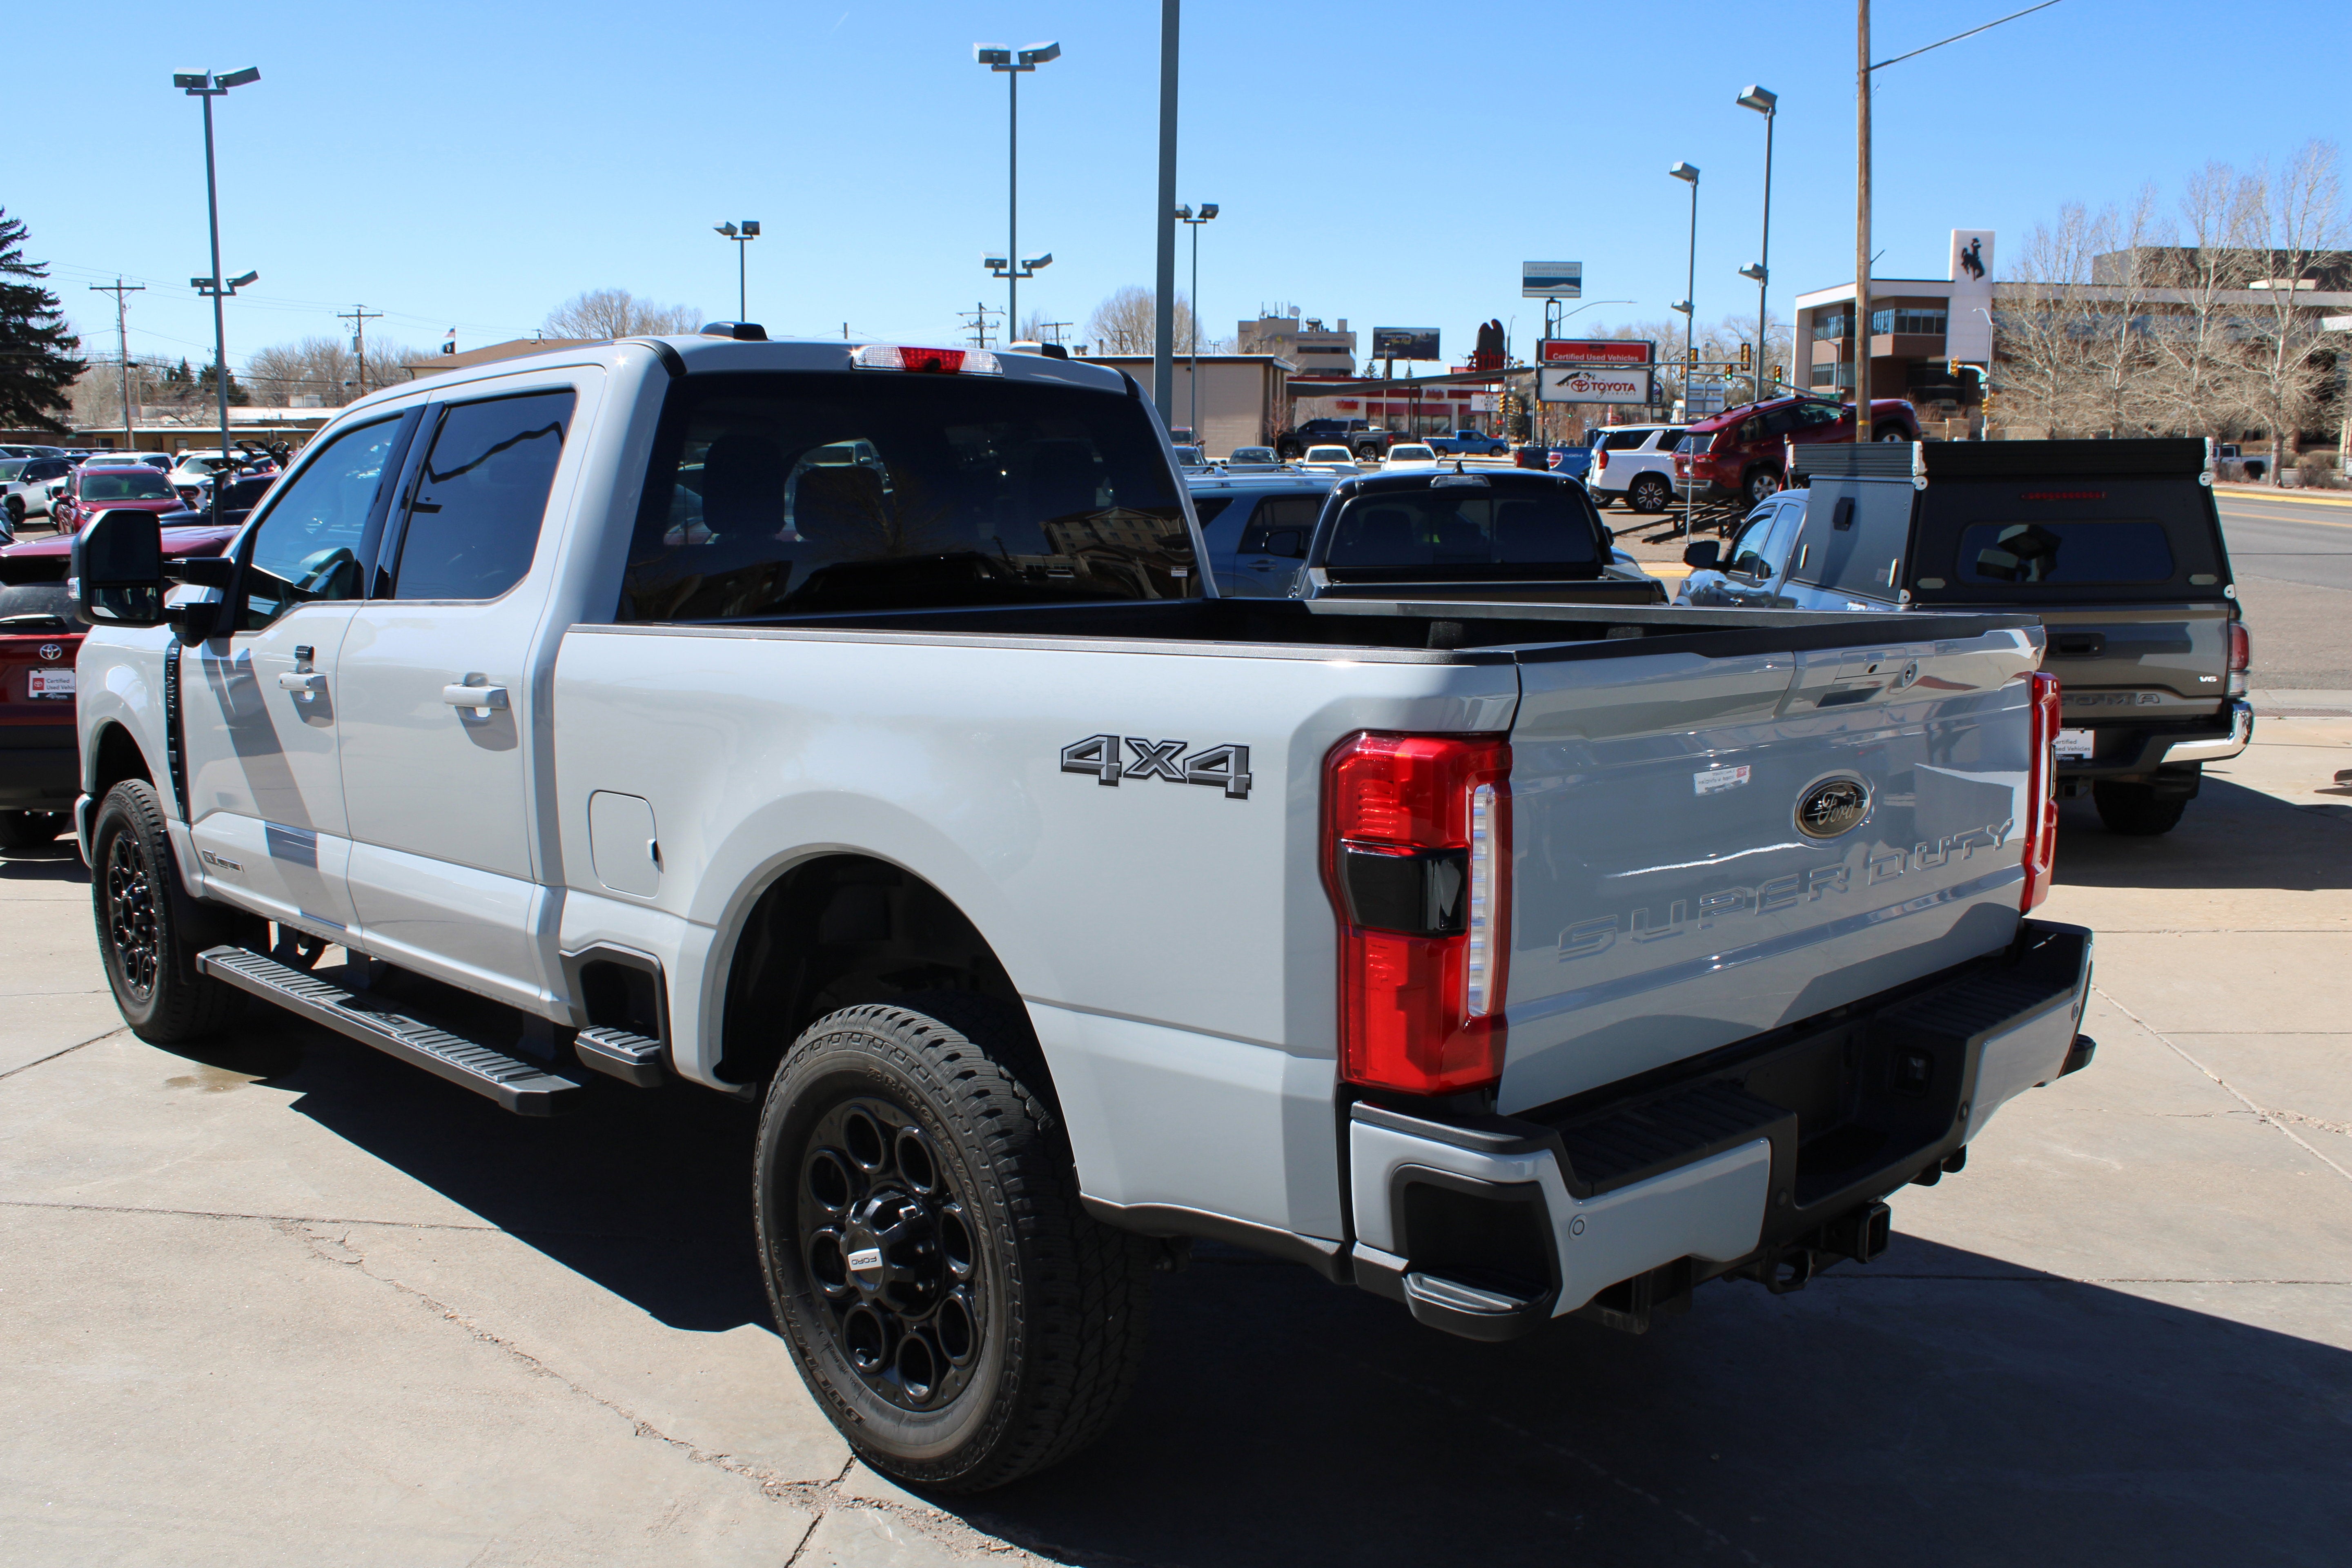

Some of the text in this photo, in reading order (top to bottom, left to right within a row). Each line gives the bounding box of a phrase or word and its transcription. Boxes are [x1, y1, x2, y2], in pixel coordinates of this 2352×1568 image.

[1591, 382, 1636, 392] TOYOTA
[1060, 733, 1252, 801] 4X4
[1817, 791, 1857, 826] Ford
[1558, 818, 2014, 963] SUPER DUTY
[867, 1064, 992, 1249] BRIDGESTONE
[851, 1256, 877, 1265] FORD
